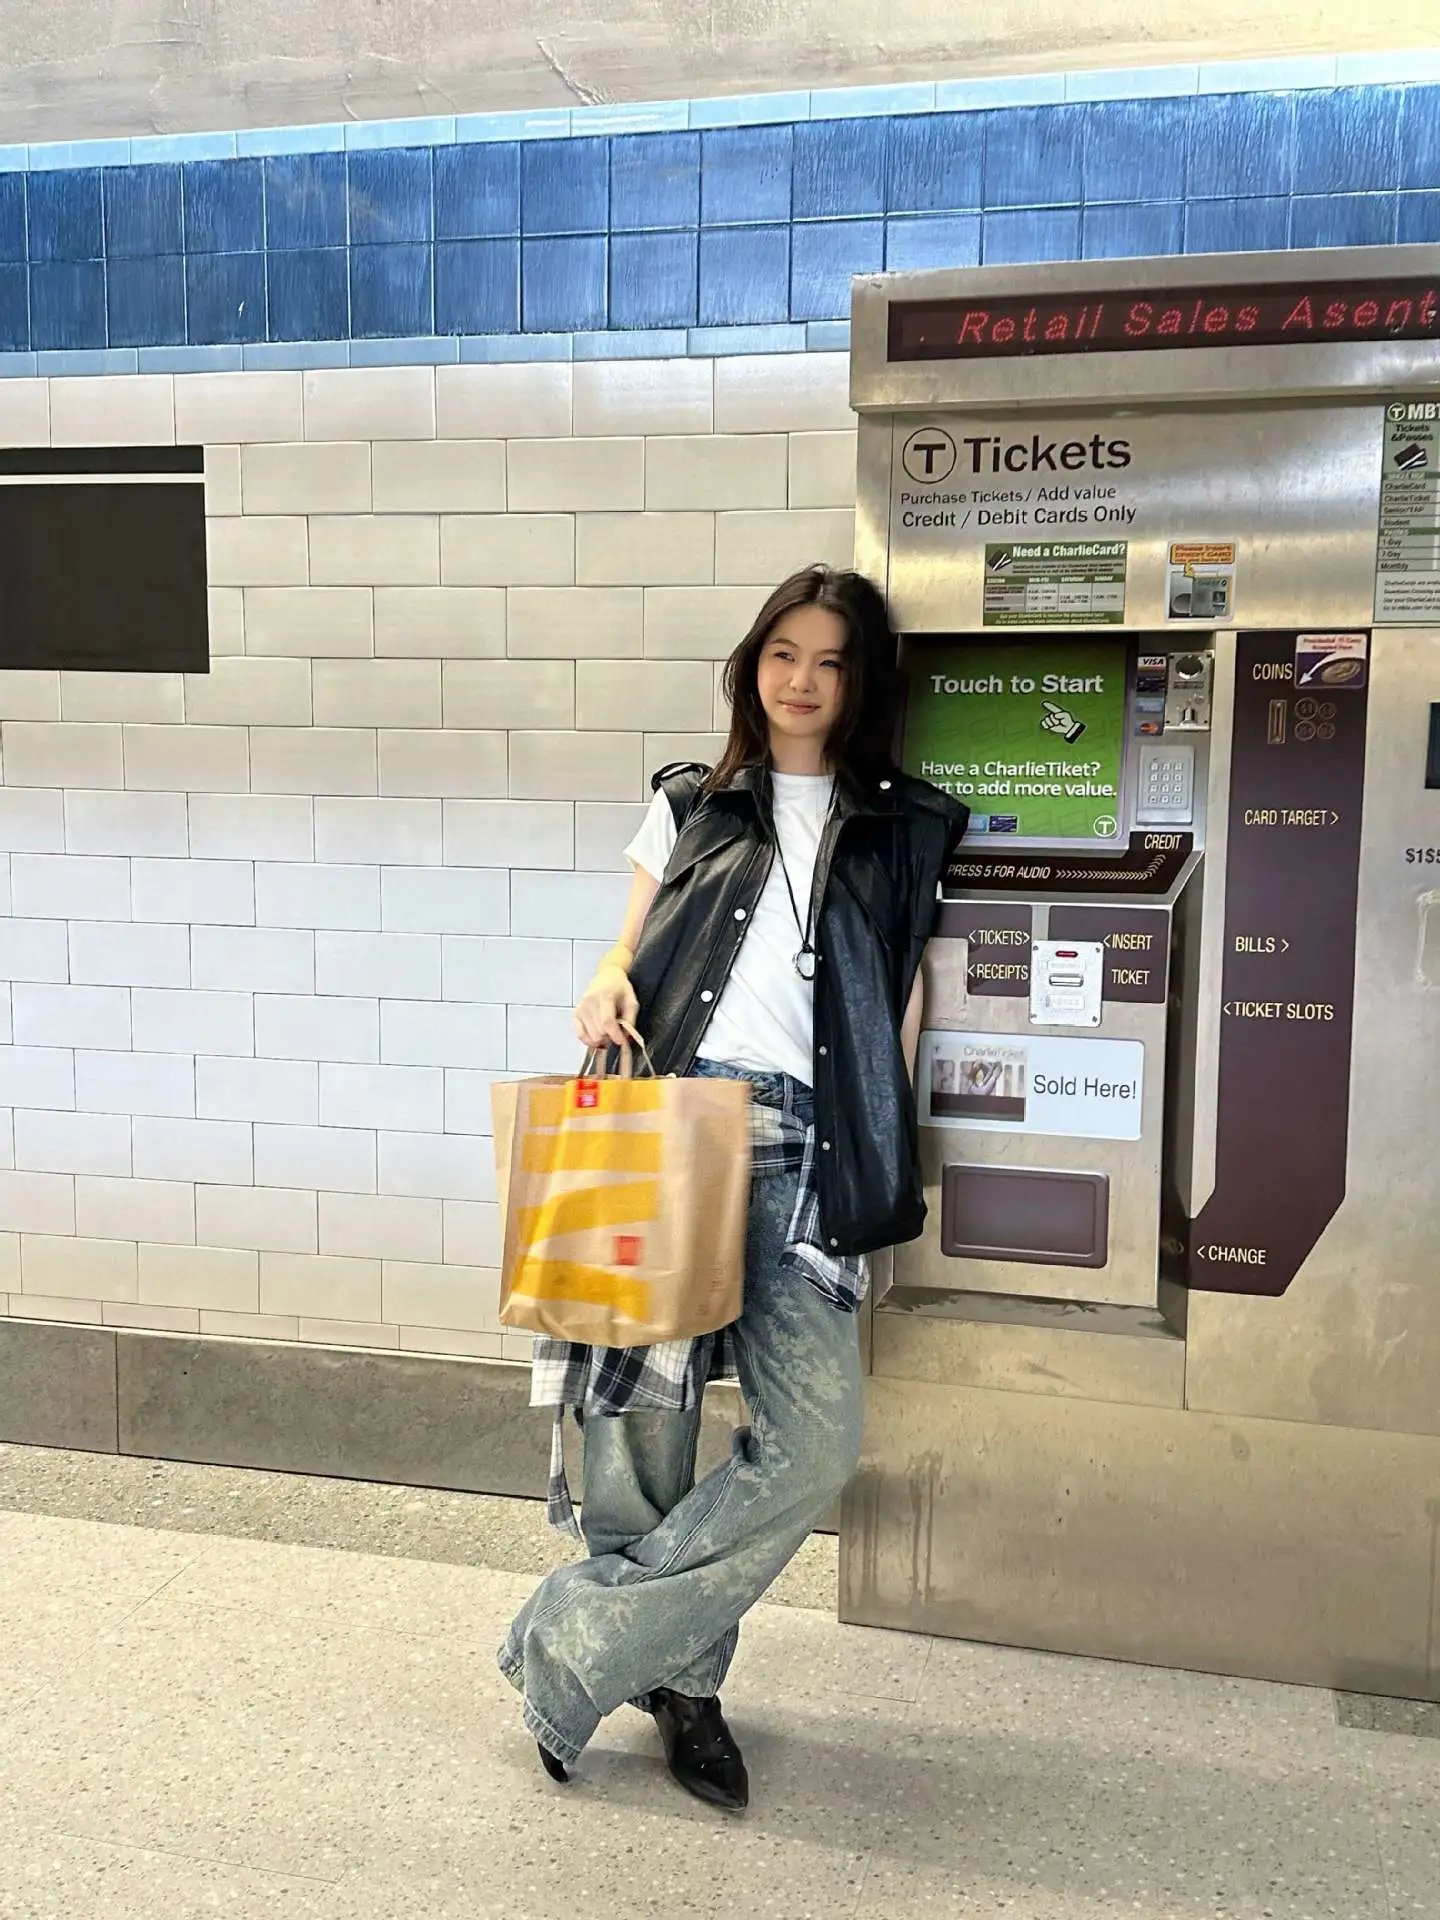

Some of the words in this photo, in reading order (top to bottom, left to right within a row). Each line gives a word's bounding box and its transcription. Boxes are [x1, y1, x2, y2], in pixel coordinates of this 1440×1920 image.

[957, 304, 1104, 344] Retail
[1124, 299, 1259, 336] Sales
[963, 434, 1132, 473] Tickets
[900, 492, 967, 505] Purchase
[1037, 485, 1069, 502] Add
[1073, 484, 1117, 500] value
[902, 511, 956, 527] Credit
[977, 508, 1028, 526] Debit
[1034, 506, 1088, 524] Cards
[1093, 504, 1137, 524] Only
[1012, 545, 1042, 558] Need
[1043, 547, 1050, 557] a
[1052, 543, 1126, 557] CharlieCard?
[1252, 663, 1294, 680] COINS
[930, 674, 1003, 694] Touch
[1010, 675, 1035, 694] to
[1041, 673, 1104, 694] Start
[921, 761, 965, 776] Have
[968, 764, 980, 776] a
[955, 781, 974, 795] to
[977, 780, 1010, 795] add
[1015, 782, 1061, 796] more
[1061, 780, 1118, 797] value.
[1244, 809, 1277, 825] CARD
[1281, 809, 1328, 825] TARGET
[1144, 834, 1183, 850] CREDIT
[947, 864, 983, 877] PRESS
[983, 865, 992, 877] 5
[993, 865, 1016, 878] FOR
[1016, 866, 1051, 879] AUDIO
[978, 930, 1023, 946] TICKETS
[1111, 933, 1153, 950] INSERT
[1235, 936, 1276, 953] BILLS
[976, 963, 1029, 980] RECEIPTS
[1111, 968, 1150, 985] TICKET
[1233, 1001, 1283, 1018] TICKET
[1286, 1002, 1334, 1020] SLOTS
[1033, 1074, 1077, 1096] Sold
[1084, 1077, 1137, 1100] Here!
[1208, 1245, 1267, 1265] CHANGE
